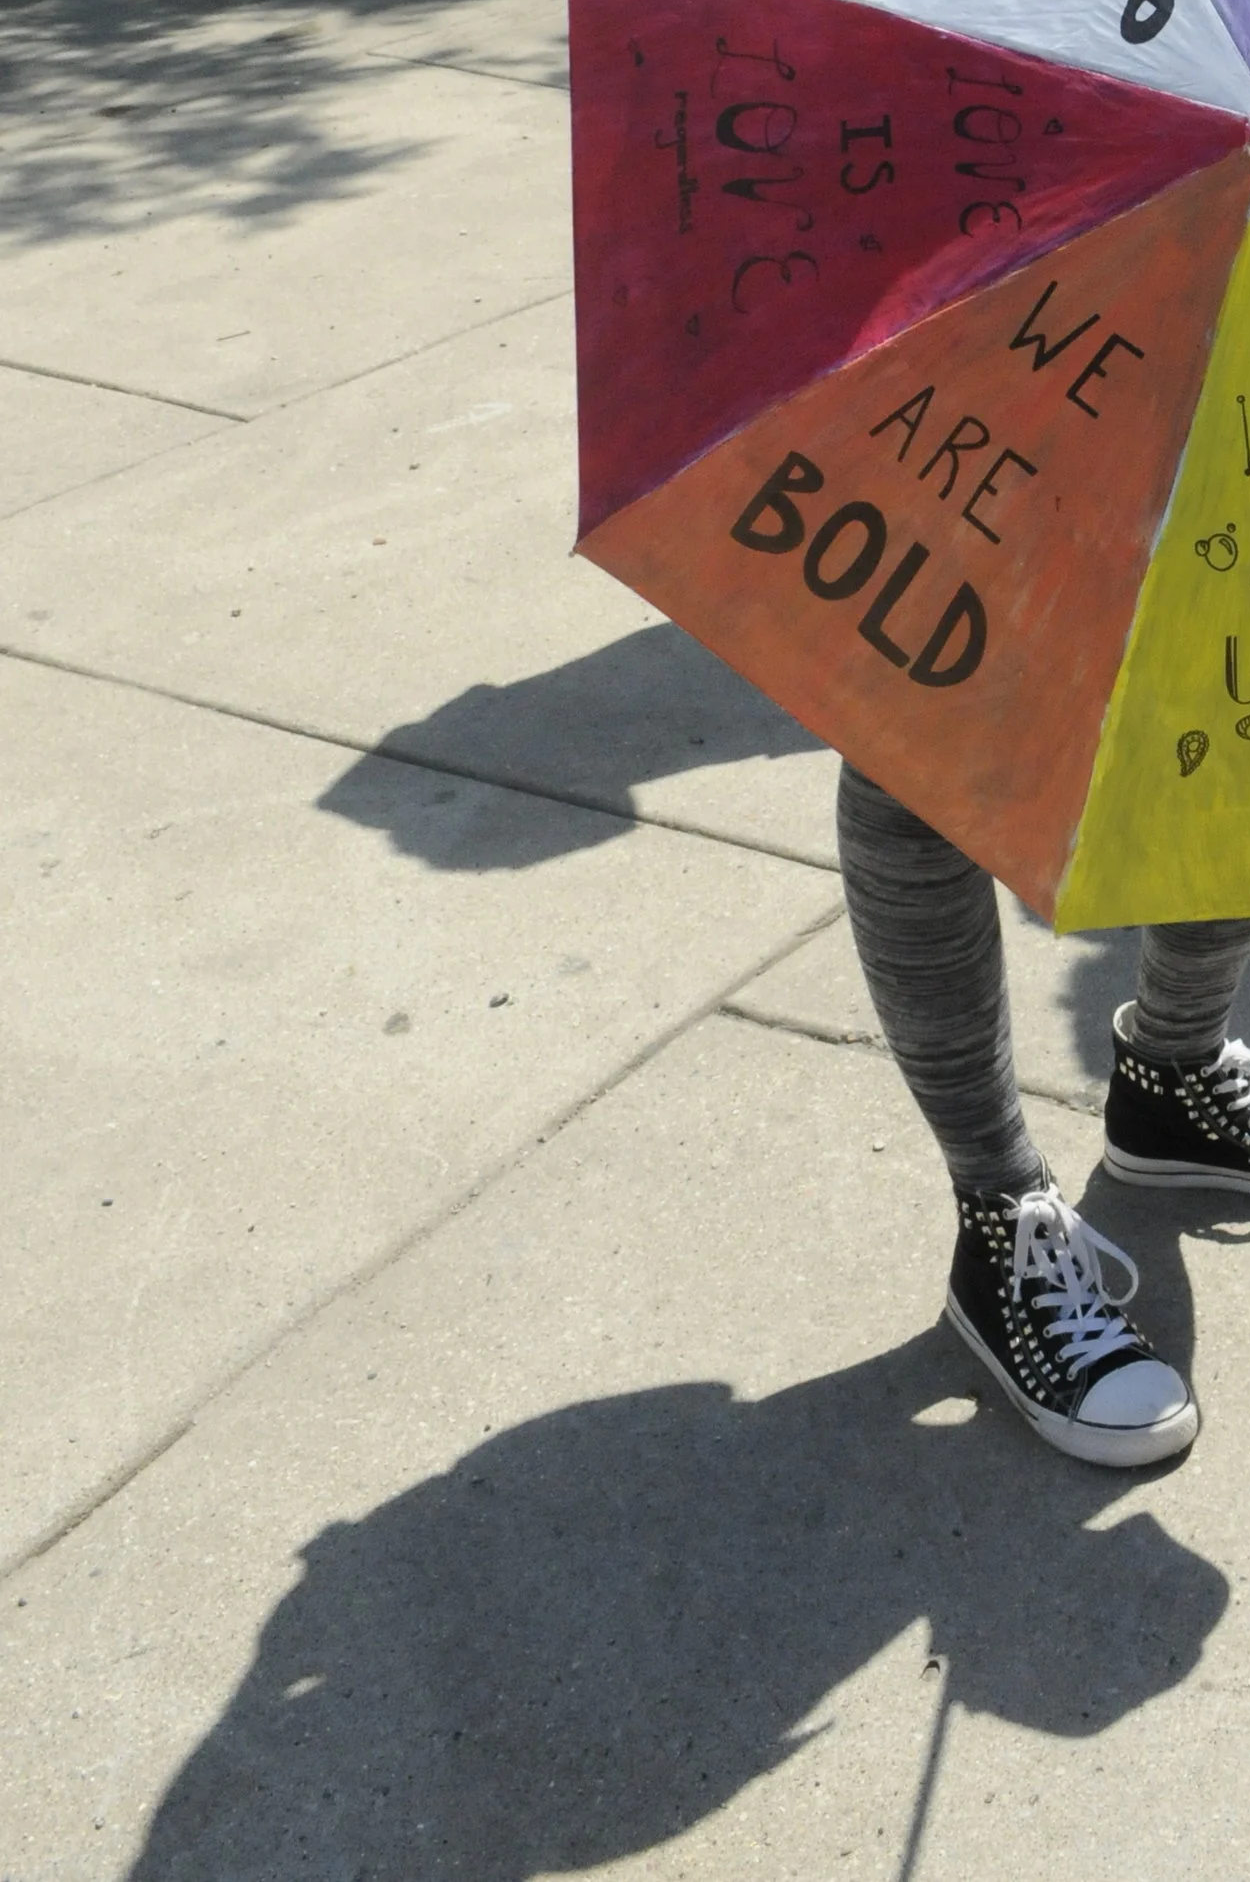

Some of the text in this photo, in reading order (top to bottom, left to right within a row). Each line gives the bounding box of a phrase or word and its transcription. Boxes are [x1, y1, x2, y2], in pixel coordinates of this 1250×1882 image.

[711, 36, 820, 315] LOVE
[840, 114, 895, 196] IS
[945, 66, 1027, 240] LOVE
[1008, 280, 1146, 419] WE
[869, 384, 1039, 545] ARE
[729, 450, 988, 688] BOLD
